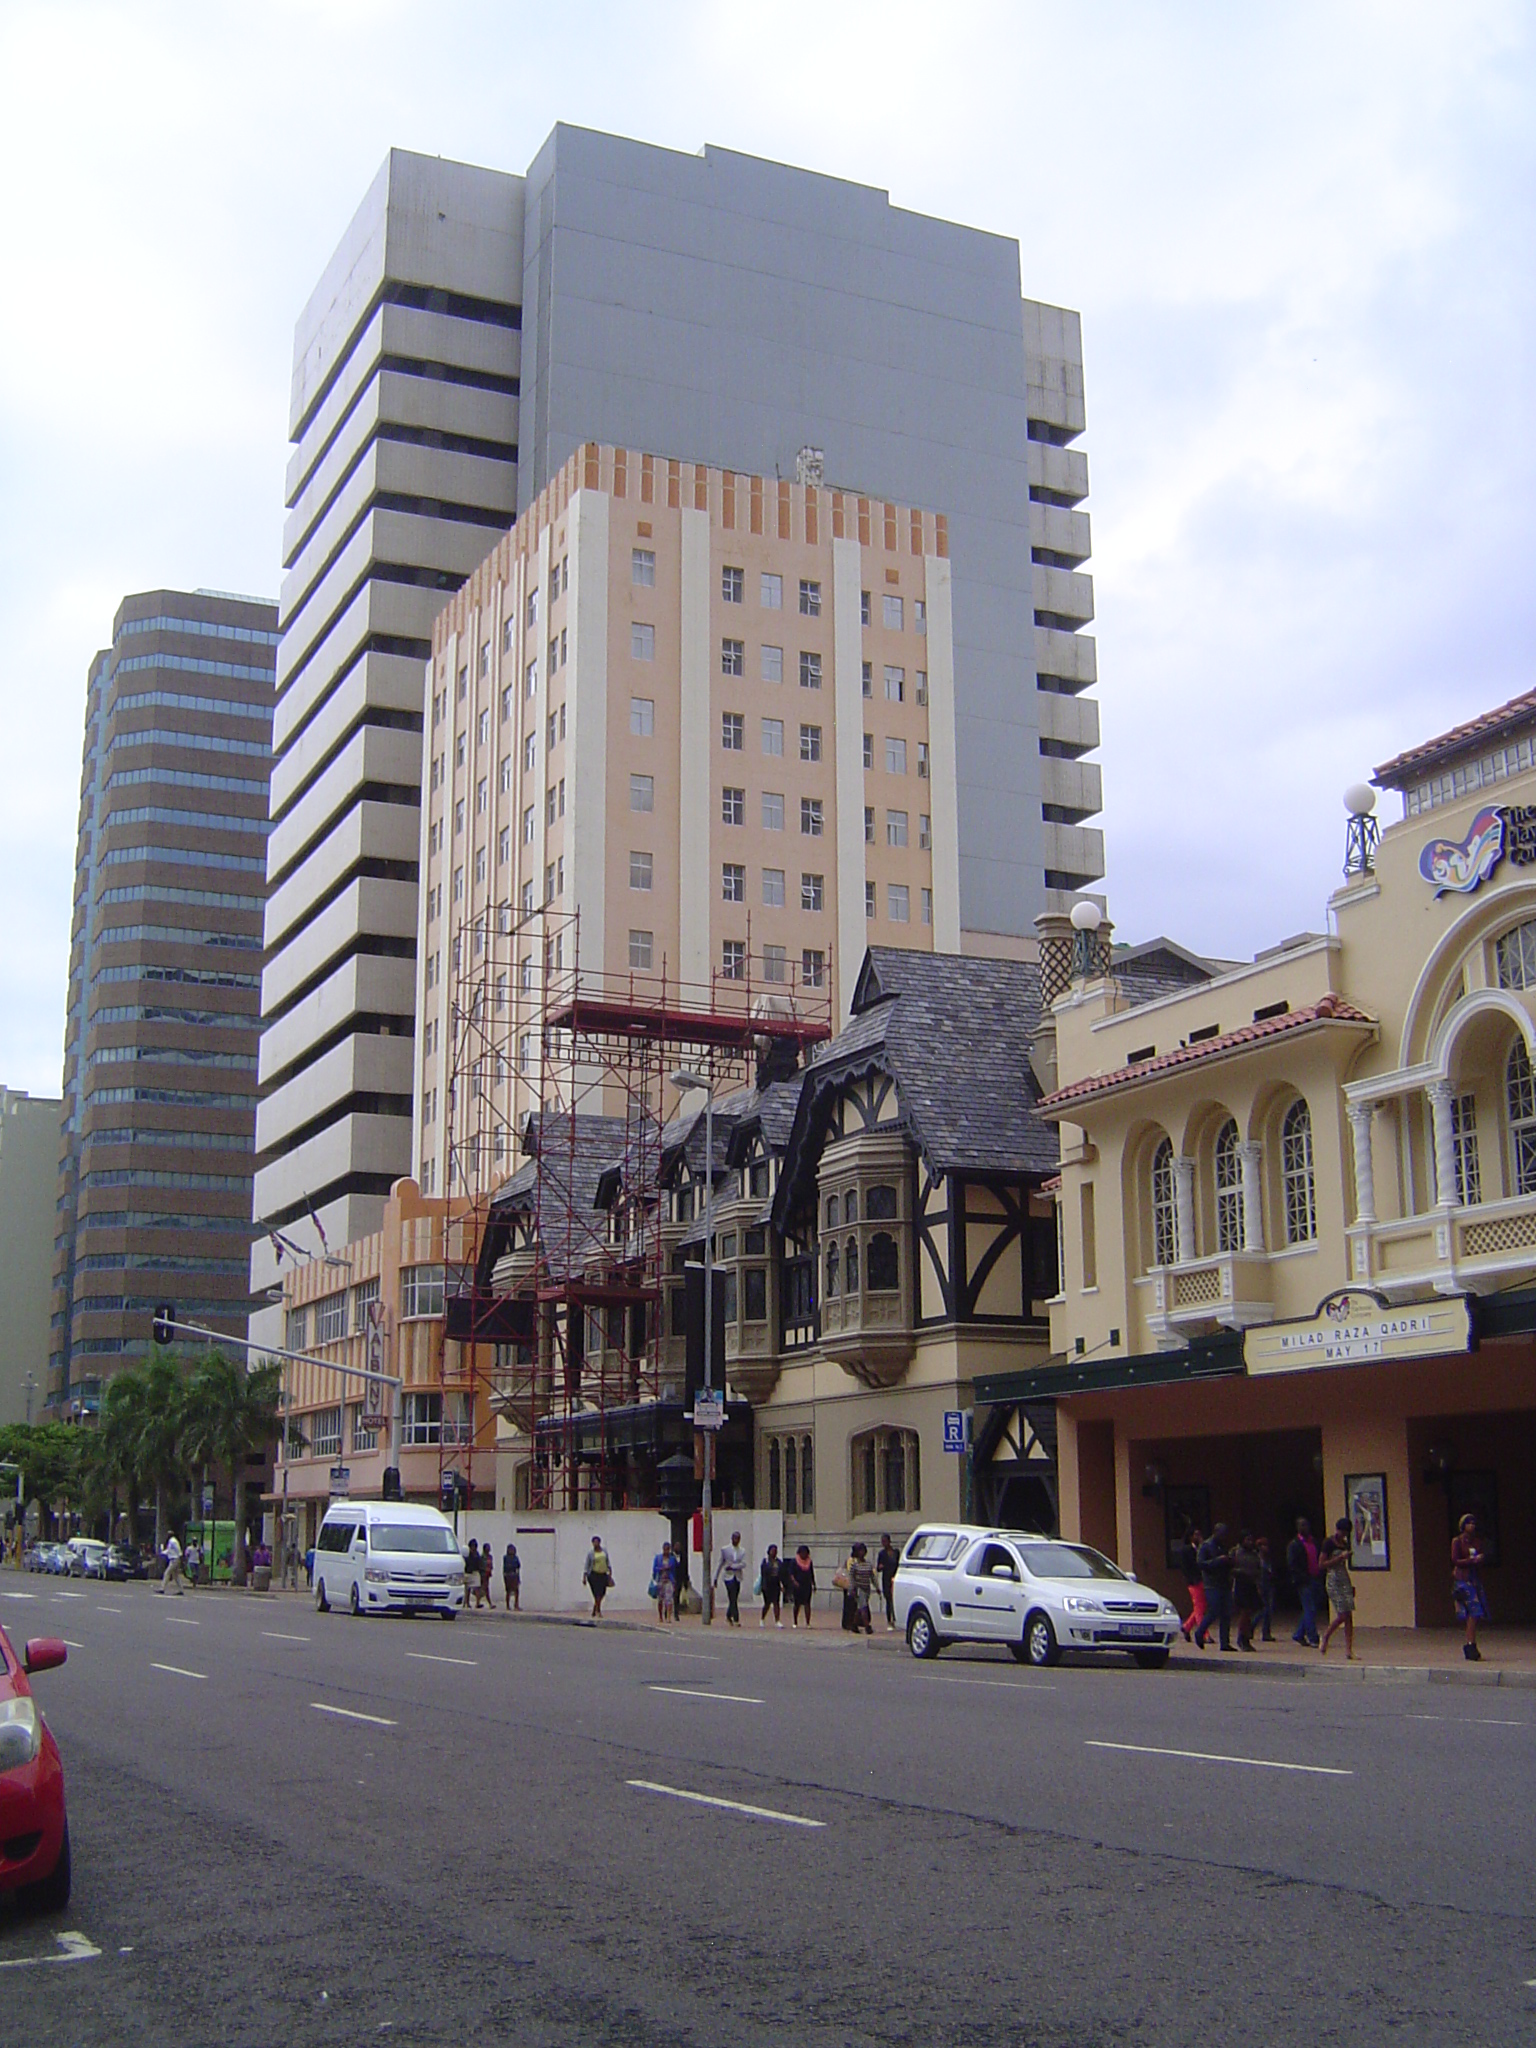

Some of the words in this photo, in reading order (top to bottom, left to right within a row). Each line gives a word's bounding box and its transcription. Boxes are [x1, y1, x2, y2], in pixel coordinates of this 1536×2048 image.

[1282, 1332, 1324, 1346] MILAD
[1335, 1327, 1370, 1340] RAZA
[1381, 1319, 1426, 1334] QADRI
[1326, 1345, 1351, 1358] MAY
[1364, 1342, 1378, 1354] 17
[362, 1417, 386, 1425] HOTEL
[949, 1426, 959, 1440] R
